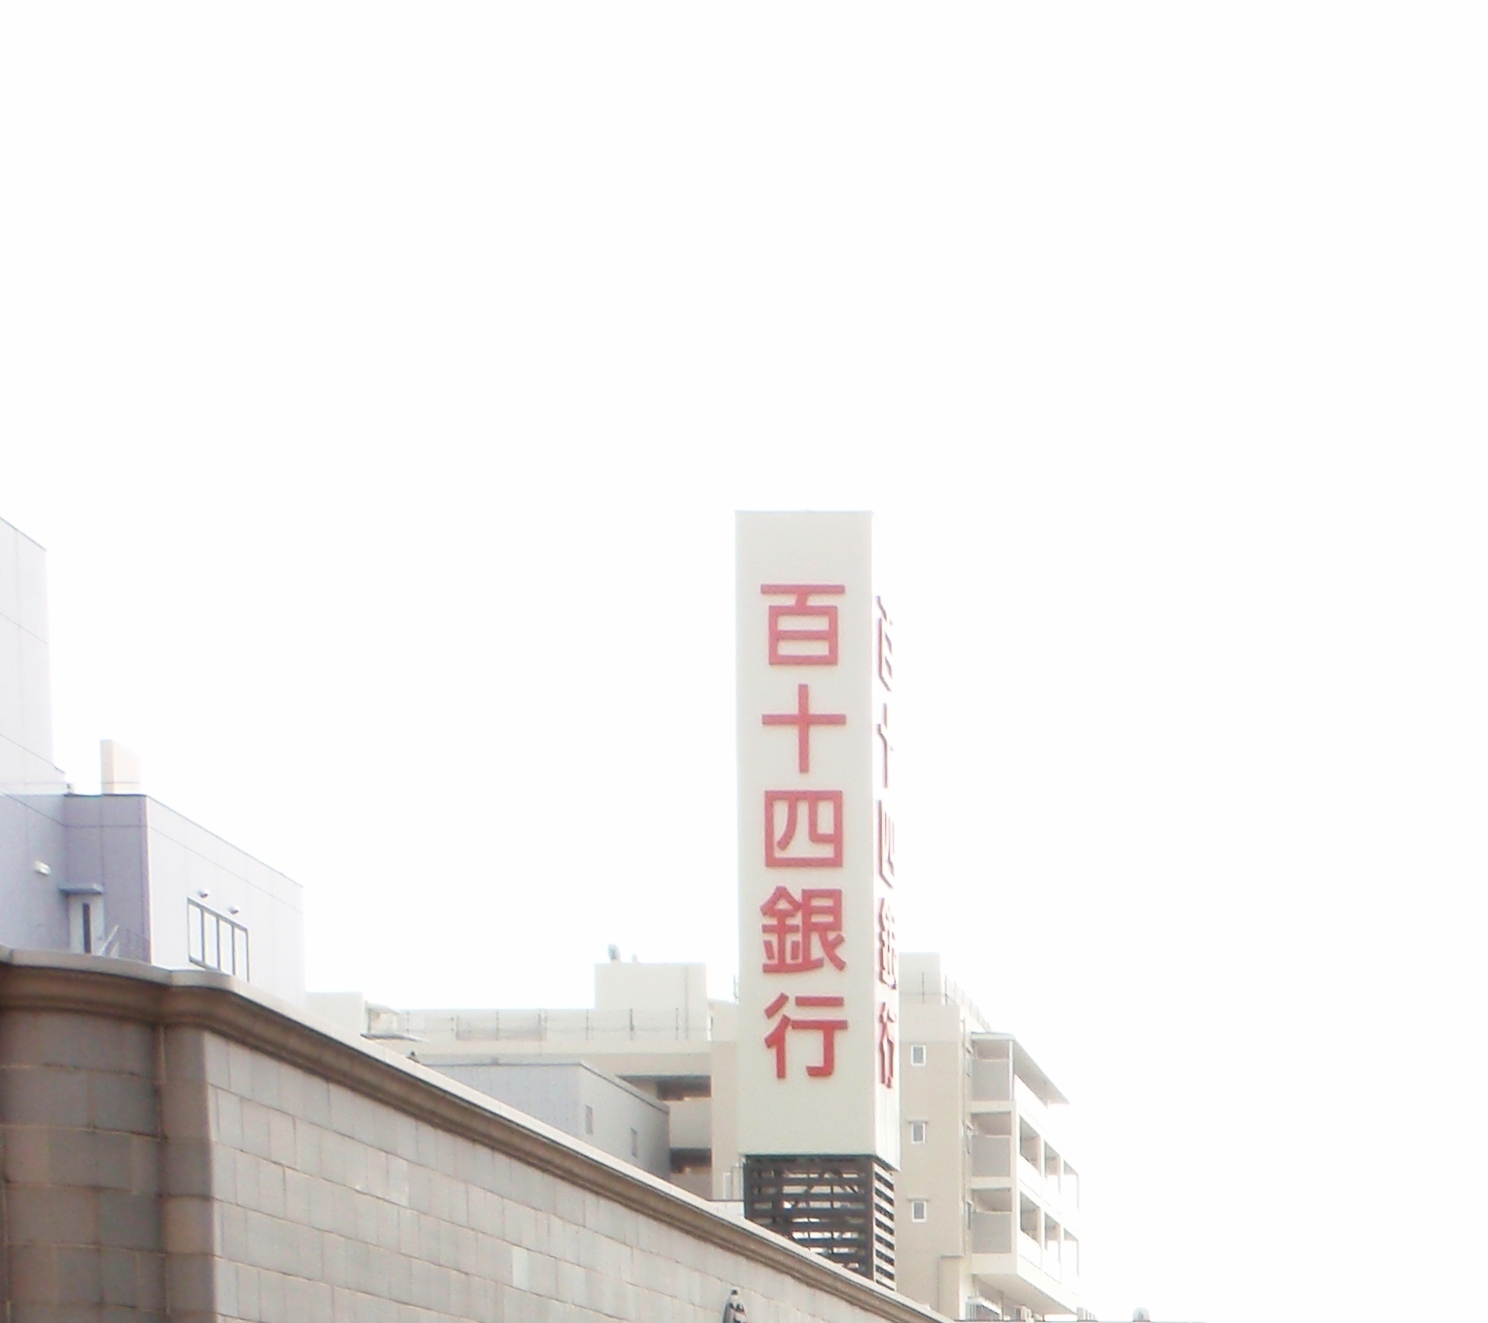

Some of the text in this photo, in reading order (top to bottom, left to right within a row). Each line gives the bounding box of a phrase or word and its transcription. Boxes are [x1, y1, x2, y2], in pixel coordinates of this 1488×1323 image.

[760, 582, 849, 1081] 百十四銀行
